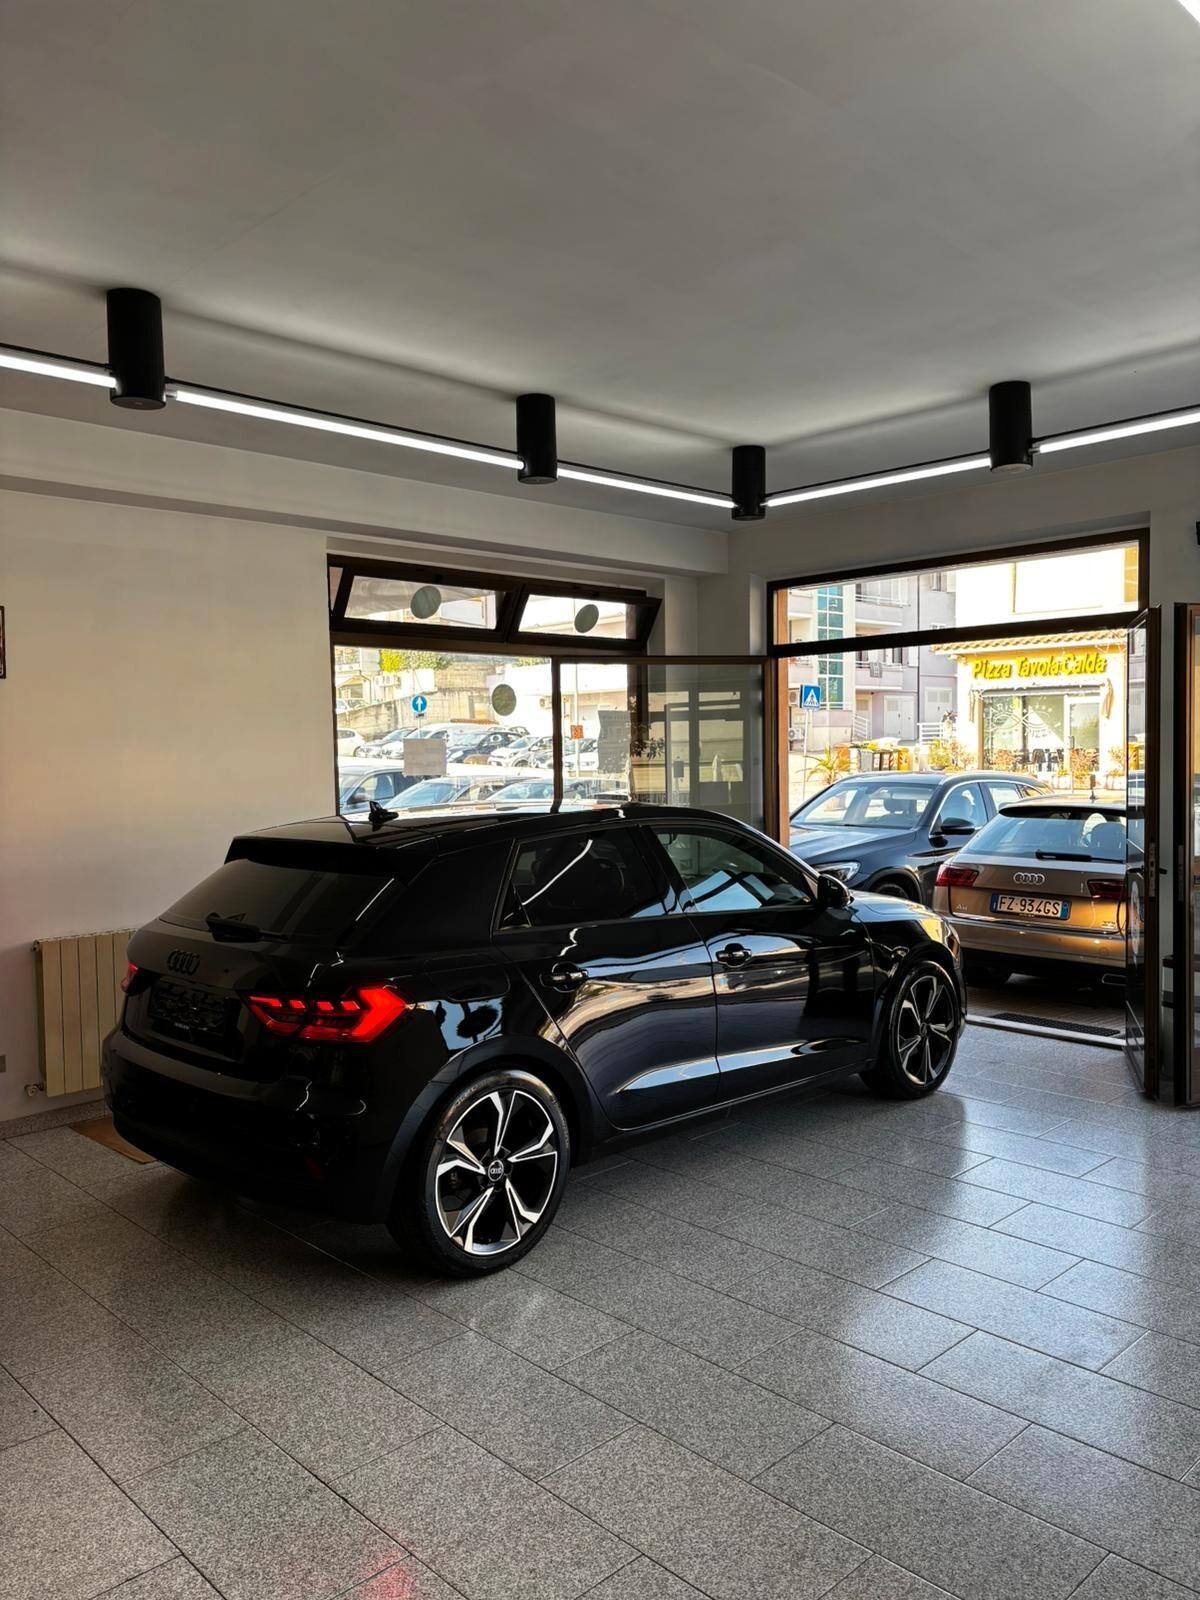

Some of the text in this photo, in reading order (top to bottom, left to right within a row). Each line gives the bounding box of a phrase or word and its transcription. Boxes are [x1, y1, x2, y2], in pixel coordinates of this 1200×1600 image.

[972, 652, 1107, 679] Pizza Tavola Calda
